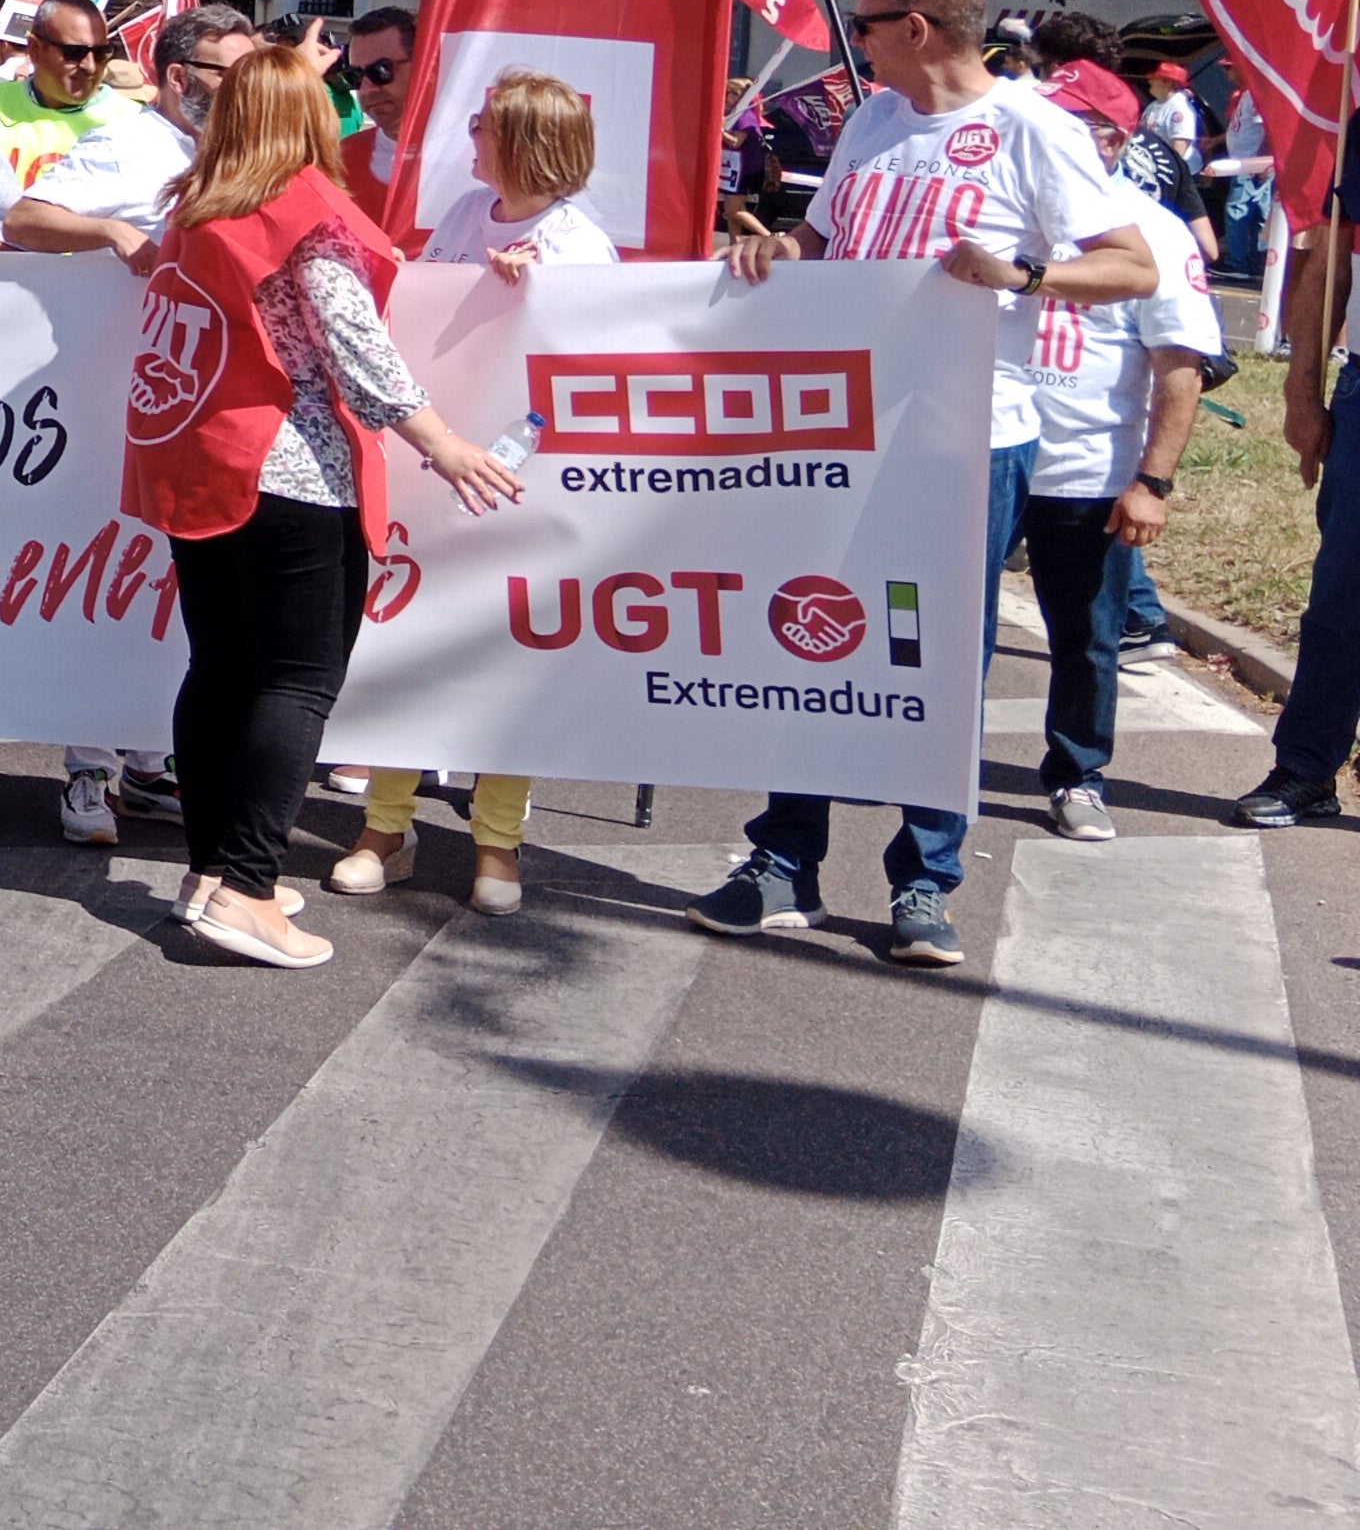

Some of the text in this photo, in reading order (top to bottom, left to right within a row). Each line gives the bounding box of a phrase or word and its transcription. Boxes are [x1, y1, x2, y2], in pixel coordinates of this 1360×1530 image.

[952, 127, 995, 149] UGT
[873, 157, 901, 172] LE
[913, 159, 991, 186] PONES
[550, 371, 850, 436] CCOO
[559, 456, 852, 495] extremadura
[506, 570, 744, 657] UGT
[644, 670, 927, 724] Extremadura
